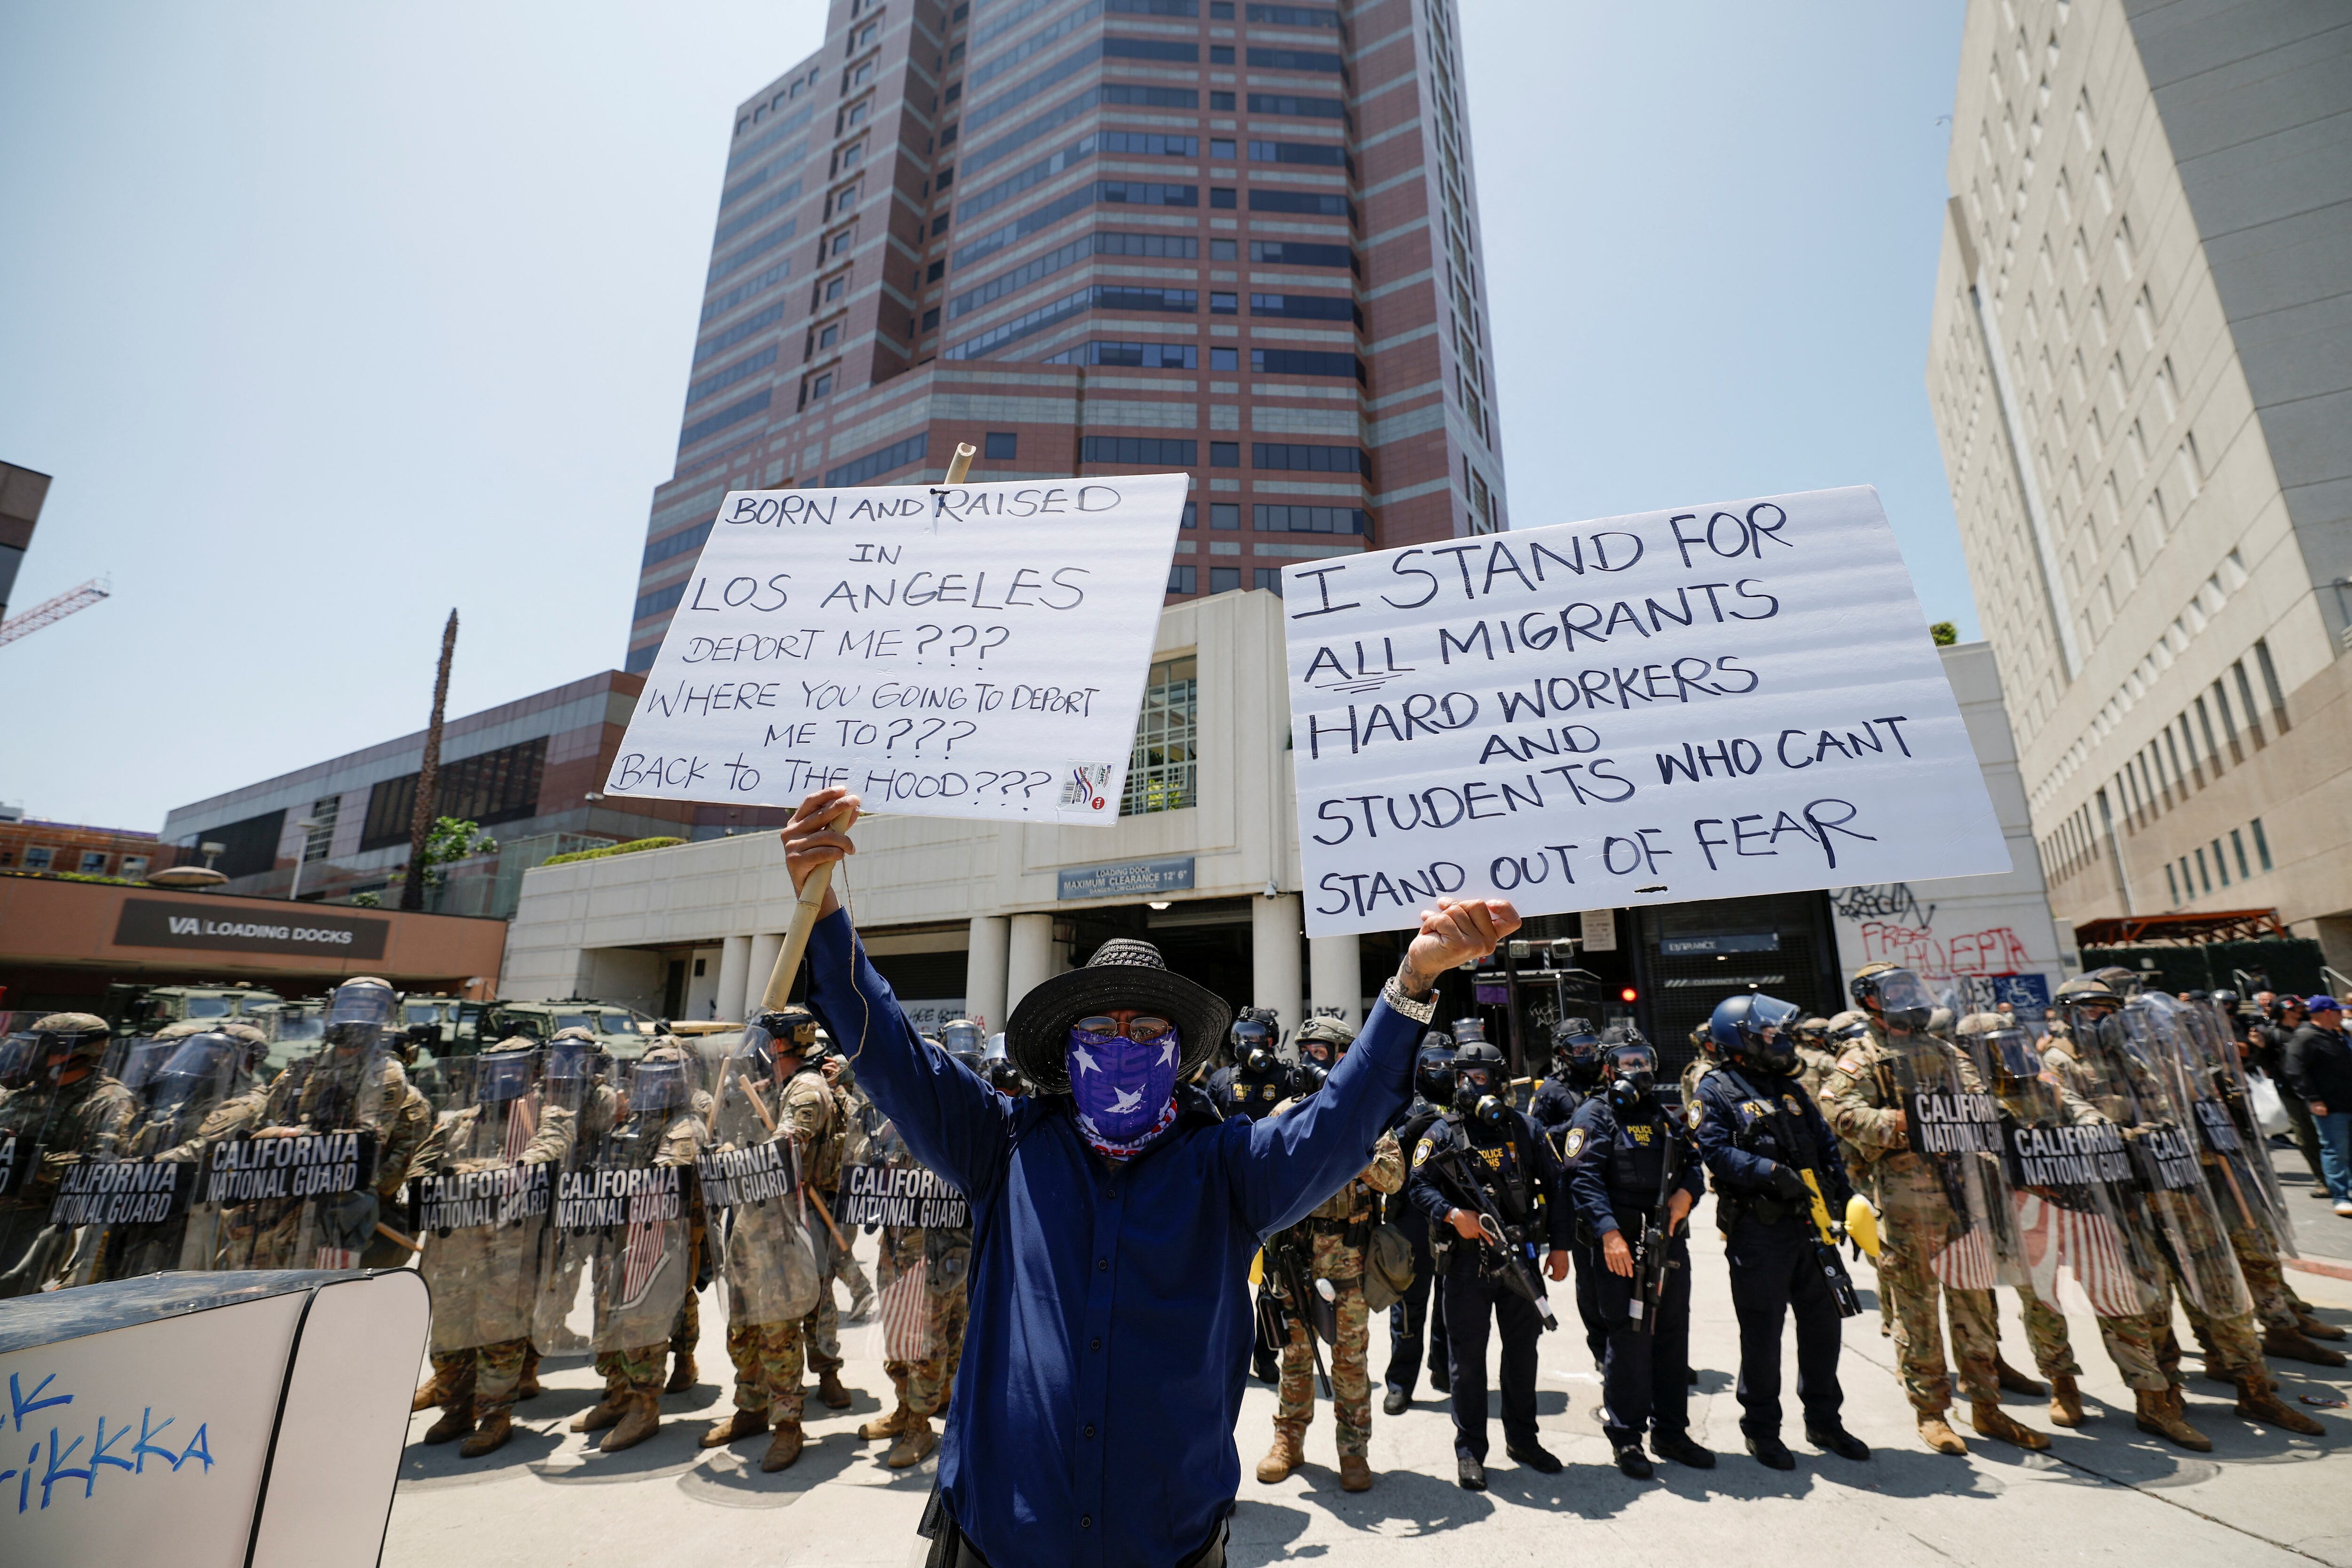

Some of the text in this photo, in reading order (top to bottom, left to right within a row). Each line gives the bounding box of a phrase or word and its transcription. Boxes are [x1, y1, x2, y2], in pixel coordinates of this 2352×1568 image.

[725, 485, 1123, 528] BORN AND RAISED
[849, 544, 901, 565] IN
[1291, 503, 1793, 619] I STAND FOR
[691, 567, 1090, 613] LOS ANGELES
[683, 629, 825, 663] DEPORT
[1304, 578, 1780, 683] ALL MIGRANTS
[648, 680, 1100, 717] WHERE YOU GOING TO DEPORT
[1310, 656, 1758, 760] HARD WORKERS
[764, 723, 817, 748] ME
[1479, 724, 1601, 765] AND
[610, 754, 709, 791] BACK
[785, 758, 849, 792] THE
[865, 769, 1051, 811] HOOD???
[1313, 716, 1911, 846] STUDENTS WHO CANT
[1096, 866, 1150, 878] LOADING DOCK
[1316, 799, 1877, 916] STAND OUT OF FEAR
[1064, 878, 1105, 890] MAXIMUM
[1109, 872, 1160, 885] CLEARANCE
[1126, 883, 1157, 891] CLEARANCE
[168, 916, 352, 945] VA LOADING DOCKS
[1669, 940, 1717, 952] ENTRANCE
[1915, 1094, 2000, 1123] CALIFORN
[1626, 1125, 1653, 1134] POLICE
[211, 1133, 359, 1172] CALIFORNIA
[1486, 1158, 1501, 1167] HS
[60, 1162, 178, 1193] CALIFORNIA
[206, 1162, 358, 1202] NATIONAL GUARD
[420, 1162, 549, 1204] CALIFORNIA
[558, 1165, 681, 1201] CALIFORNIA
[741, 1168, 788, 1203] GUARD
[850, 1166, 962, 1202] CALIFORN
[2020, 1155, 2102, 1186] NATIONAL
[107, 1193, 173, 1223] GUARD
[419, 1188, 549, 1231] NATIONAL GUARD
[555, 1193, 679, 1228] NATIONAL GUARD
[846, 1194, 966, 1228] NATIONAL GUARD
